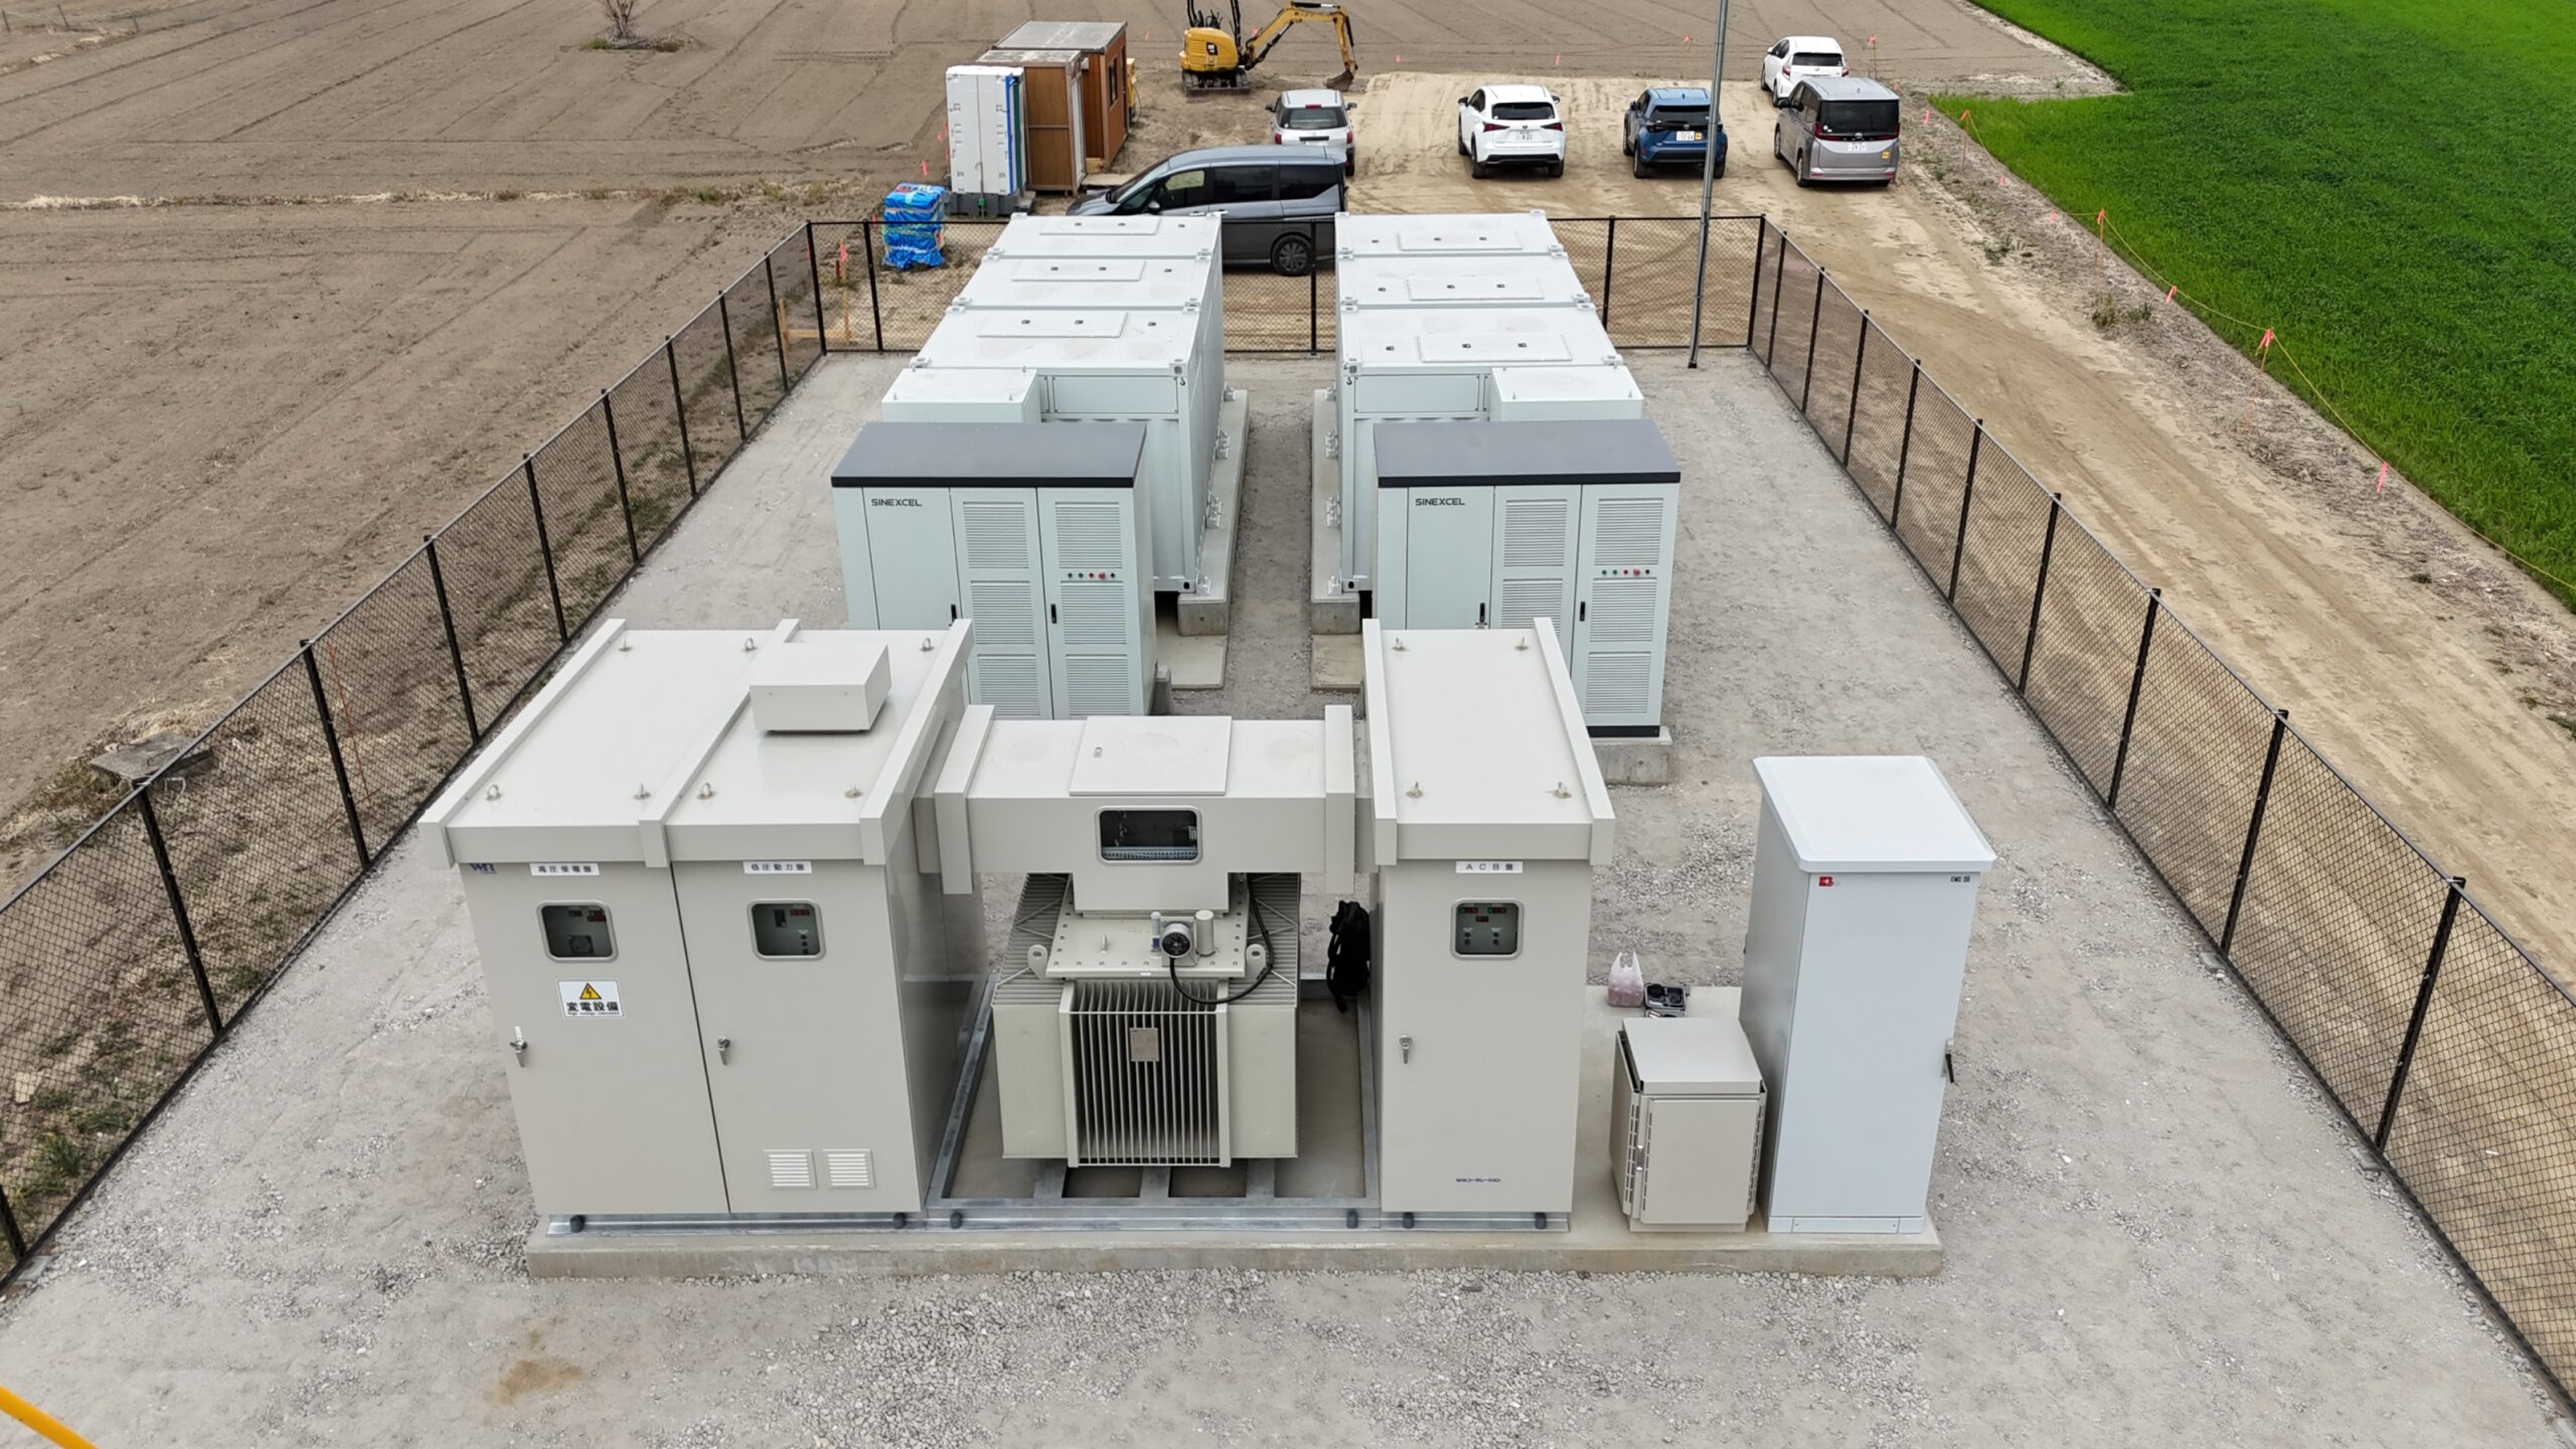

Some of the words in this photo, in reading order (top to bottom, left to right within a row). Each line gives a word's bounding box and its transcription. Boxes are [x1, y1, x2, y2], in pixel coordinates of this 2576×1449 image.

[871, 498, 923, 507] SINEXCEL
[1414, 497, 1465, 506] SINEXCEL
[566, 1001, 618, 1012] 変電設備
